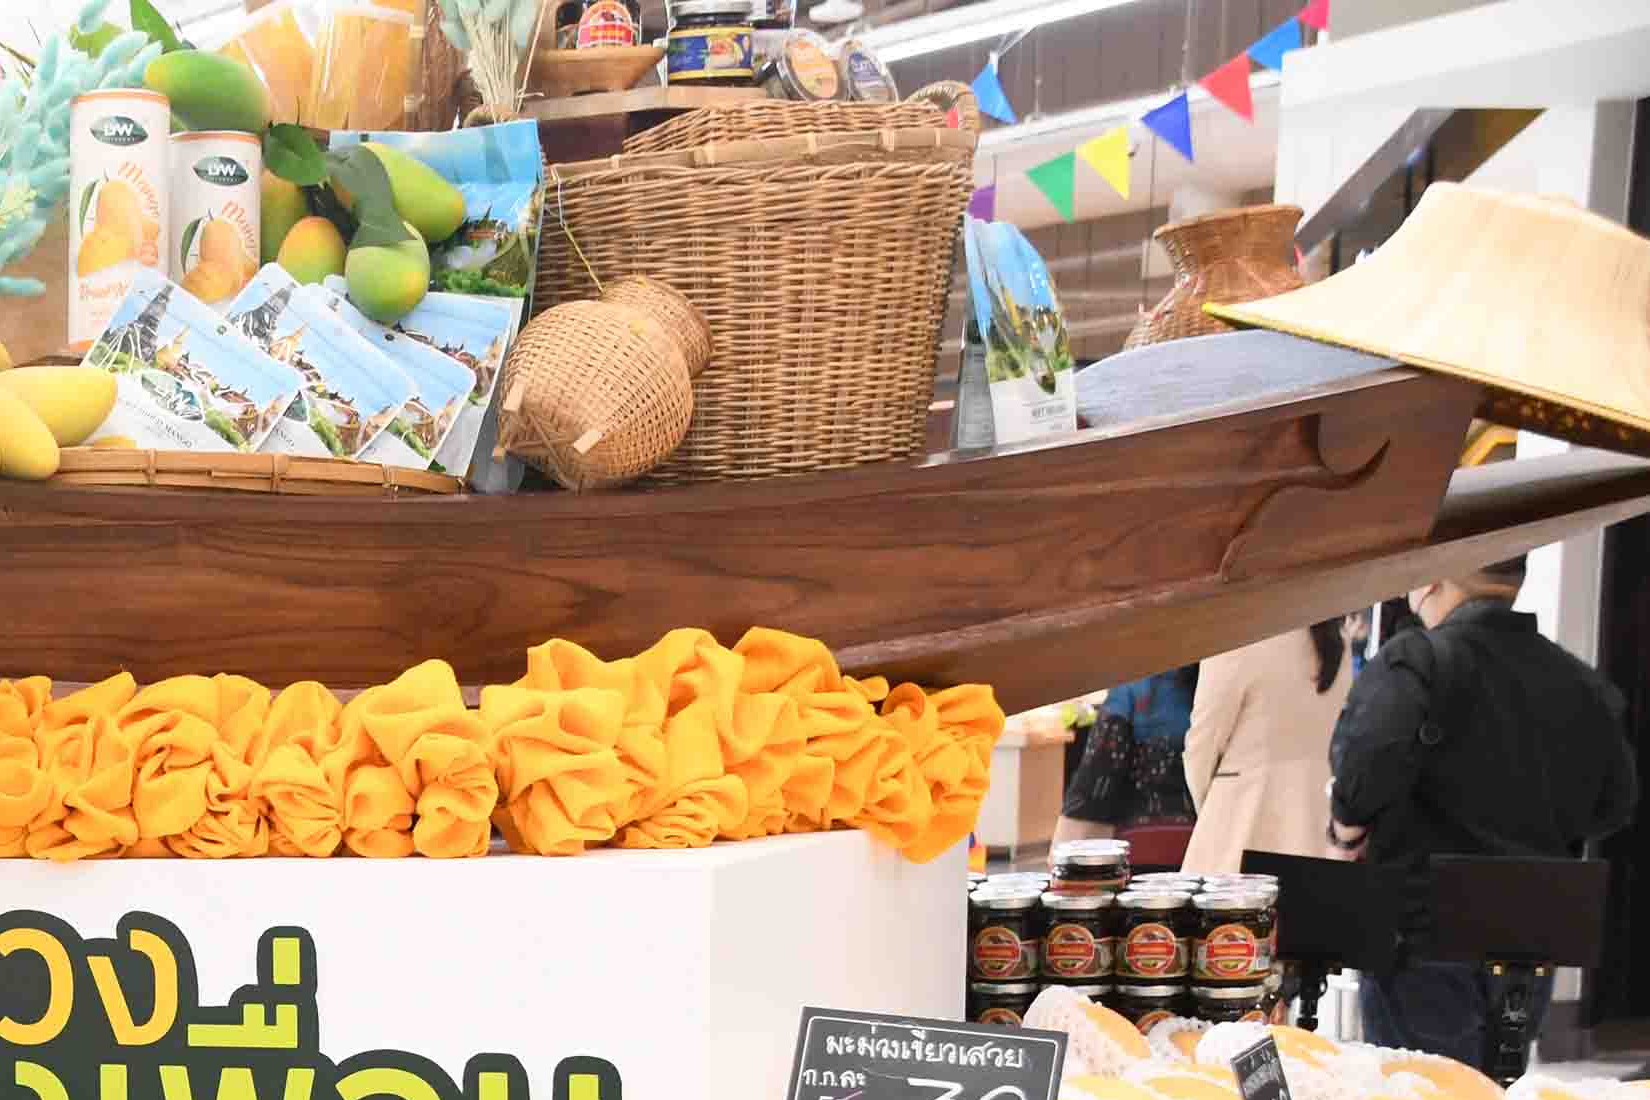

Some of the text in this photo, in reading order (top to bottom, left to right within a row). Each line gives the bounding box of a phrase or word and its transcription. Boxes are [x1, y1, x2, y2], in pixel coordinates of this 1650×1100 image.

[825, 1025, 1023, 1068] มะม่วงเขียวเสวย
